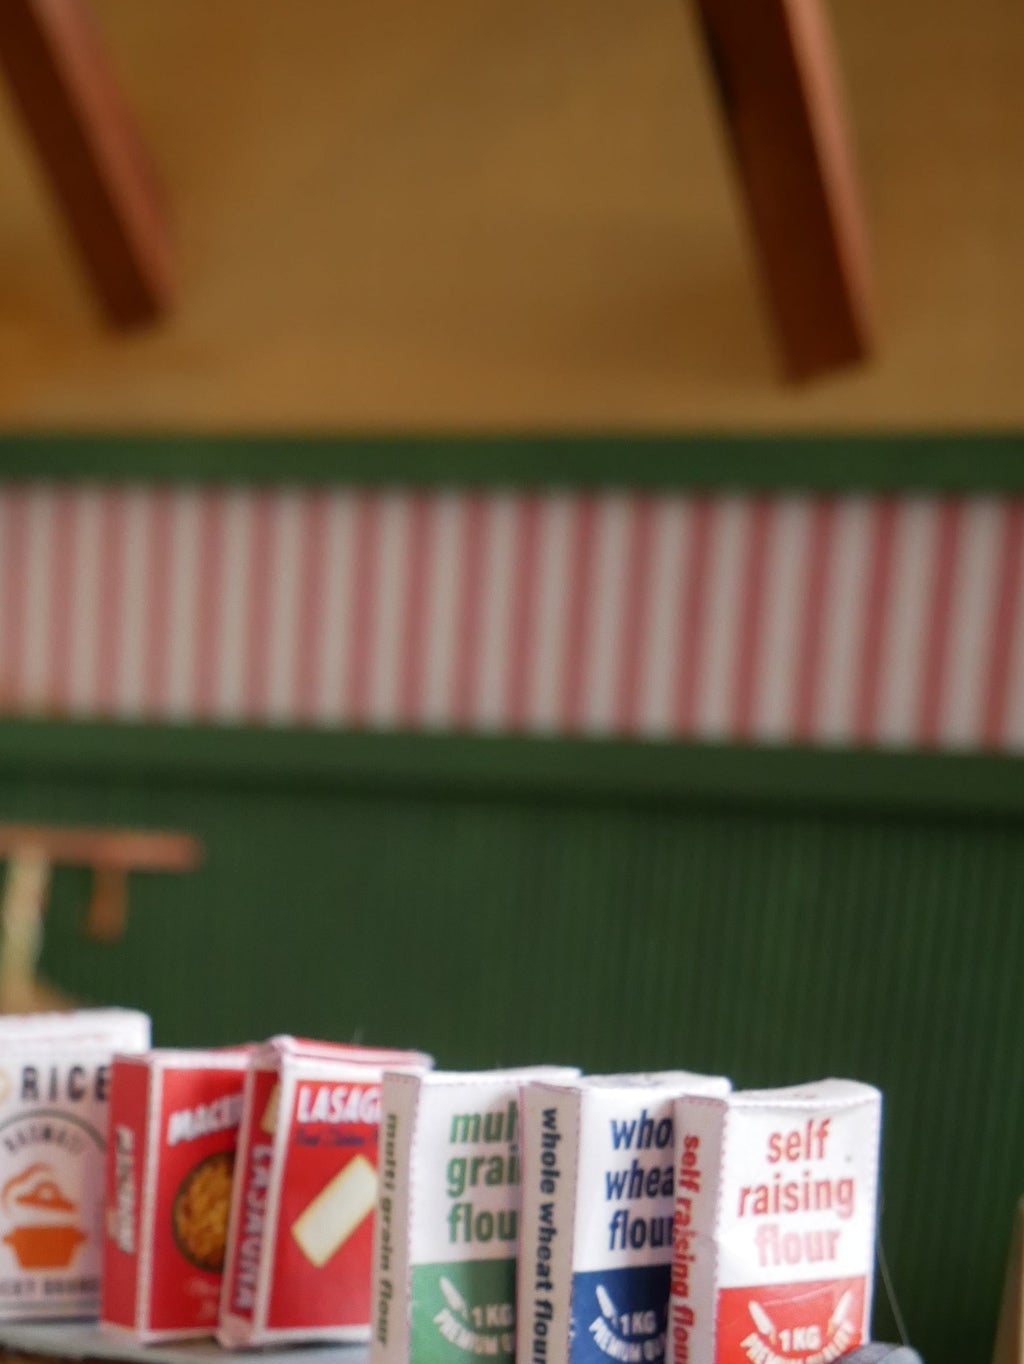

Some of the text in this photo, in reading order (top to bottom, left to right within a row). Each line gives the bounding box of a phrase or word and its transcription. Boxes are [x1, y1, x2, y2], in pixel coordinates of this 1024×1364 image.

[22, 1066, 110, 1102] RICE
[296, 1085, 381, 1124] LASAG
[450, 1101, 519, 1143] mul
[611, 1109, 673, 1150] who
[767, 1119, 832, 1164] self
[447, 1144, 520, 1198] grai
[540, 1108, 561, 1195] whole
[678, 1135, 700, 1194] self
[605, 1159, 674, 1201] whea
[737, 1171, 855, 1221] raising
[447, 1203, 517, 1243] flou
[755, 1223, 841, 1267] flour
[535, 1202, 557, 1291] wheat
[670, 1198, 697, 1298] raising
[378, 1278, 394, 1346] flour
